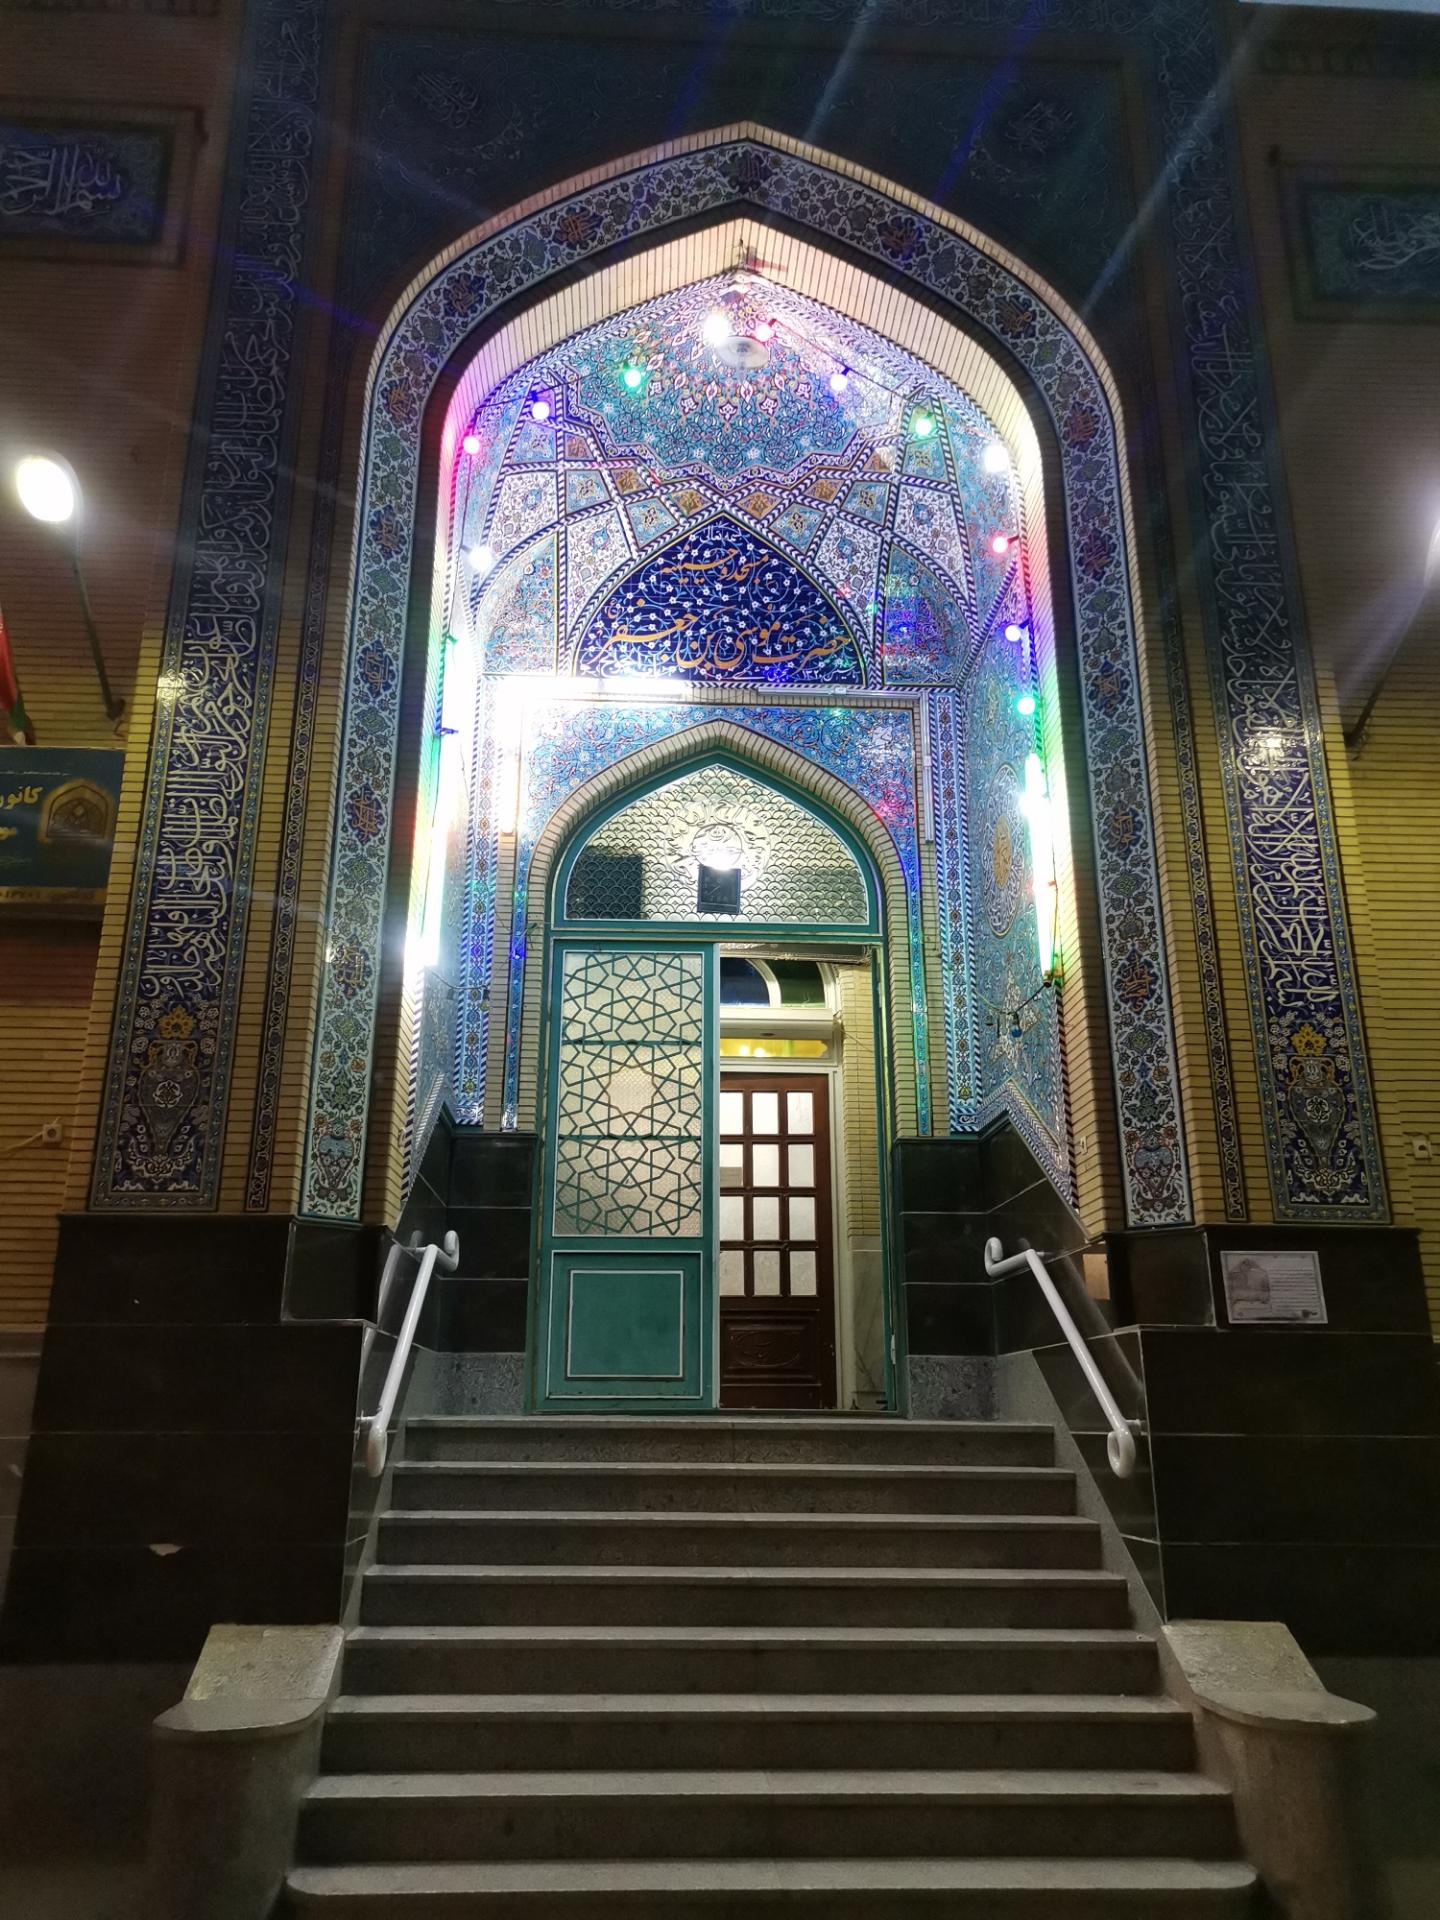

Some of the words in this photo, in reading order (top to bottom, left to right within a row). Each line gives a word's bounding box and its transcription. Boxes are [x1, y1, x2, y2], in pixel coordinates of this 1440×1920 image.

[661, 547, 739, 585] حسینیه
[727, 554, 770, 584] مسجد
[589, 611, 698, 665] جعفر
[752, 615, 851, 675] حضرت
